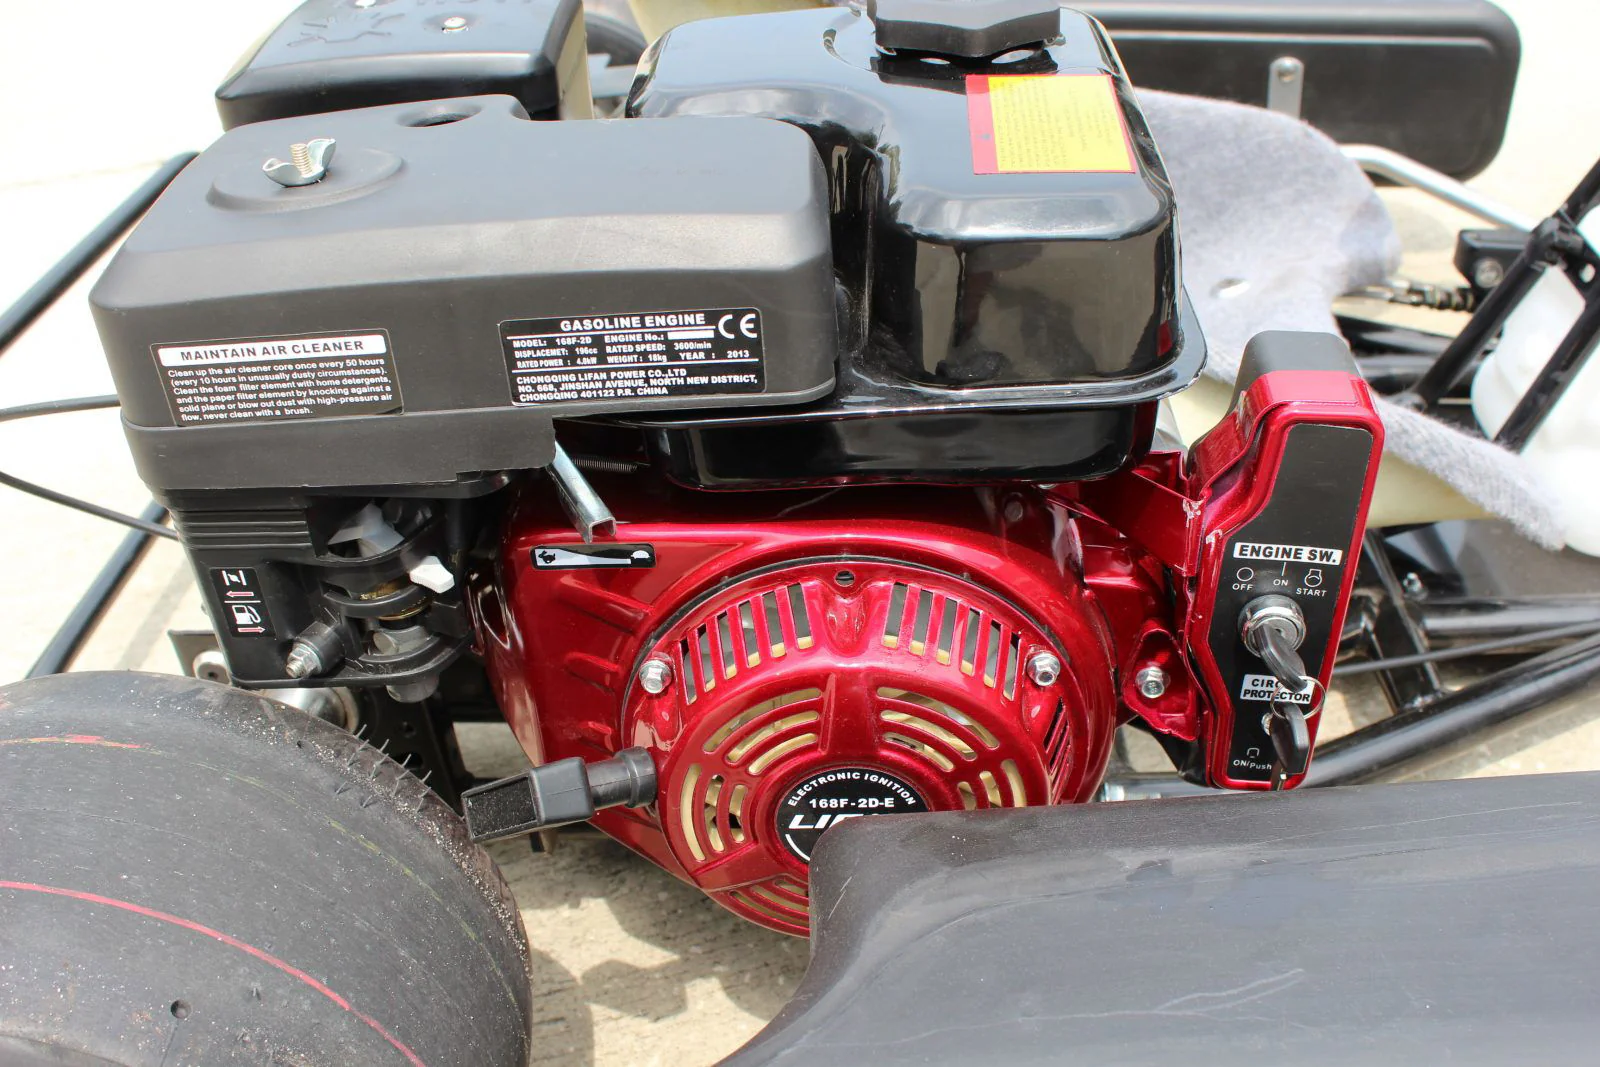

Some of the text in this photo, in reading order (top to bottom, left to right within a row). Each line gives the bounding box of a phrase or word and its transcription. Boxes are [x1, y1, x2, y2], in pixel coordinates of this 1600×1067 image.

[560, 314, 705, 331] GASOLINE ENGINE
[718, 314, 758, 339] CE
[513, 337, 592, 348] MODEL: 168F-2D
[604, 334, 642, 343] ENGINE
[674, 341, 712, 350] 3600/min
[181, 341, 363, 361] MAINTAIN AIR CLEANER
[515, 348, 568, 358] DISPLACEMET:
[606, 343, 666, 354] RATED SPEED:
[679, 352, 705, 360] YEAR
[727, 350, 749, 358] 2013
[168, 369, 194, 377] Clean
[196, 369, 206, 377] up
[225, 366, 236, 374] air
[239, 365, 271, 373] cleaner
[319, 360, 344, 368] every
[517, 360, 539, 368] RATED
[540, 359, 563, 367] POWER
[171, 379, 197, 387] (every
[248, 372, 290, 381] unusually
[292, 371, 315, 379] dusty
[318, 367, 387, 377] circumstances).
[517, 374, 576, 385] CHONGQING
[578, 372, 607, 381] LIFAN
[611, 370, 646, 379] POWER
[518, 375, 757, 393] NO. 668, JINSHAN AVENUE, NORTH NEW DISTRICT,
[174, 386, 198, 395] Clean
[261, 381, 296, 389] element
[342, 376, 391, 385] detergents,
[210, 394, 235, 403] paper
[259, 390, 295, 398] element
[309, 387, 349, 396] knocking
[351, 385, 383, 394] against
[520, 392, 578, 402] CHONGQING
[580, 389, 615, 398] 401122
[637, 387, 668, 395] CHINA
[201, 404, 225, 412] plane
[317, 394, 379, 405] high-pressure
[203, 412, 228, 420] never
[230, 410, 254, 418] clean
[285, 407, 312, 415] brush.
[1239, 545, 1336, 563] ENGINE SW.
[1232, 583, 1253, 591] OFF
[1296, 587, 1327, 597] START
[1233, 759, 1272, 770] ON/Push
[788, 772, 916, 807] ELECTRONIC IGNITION
